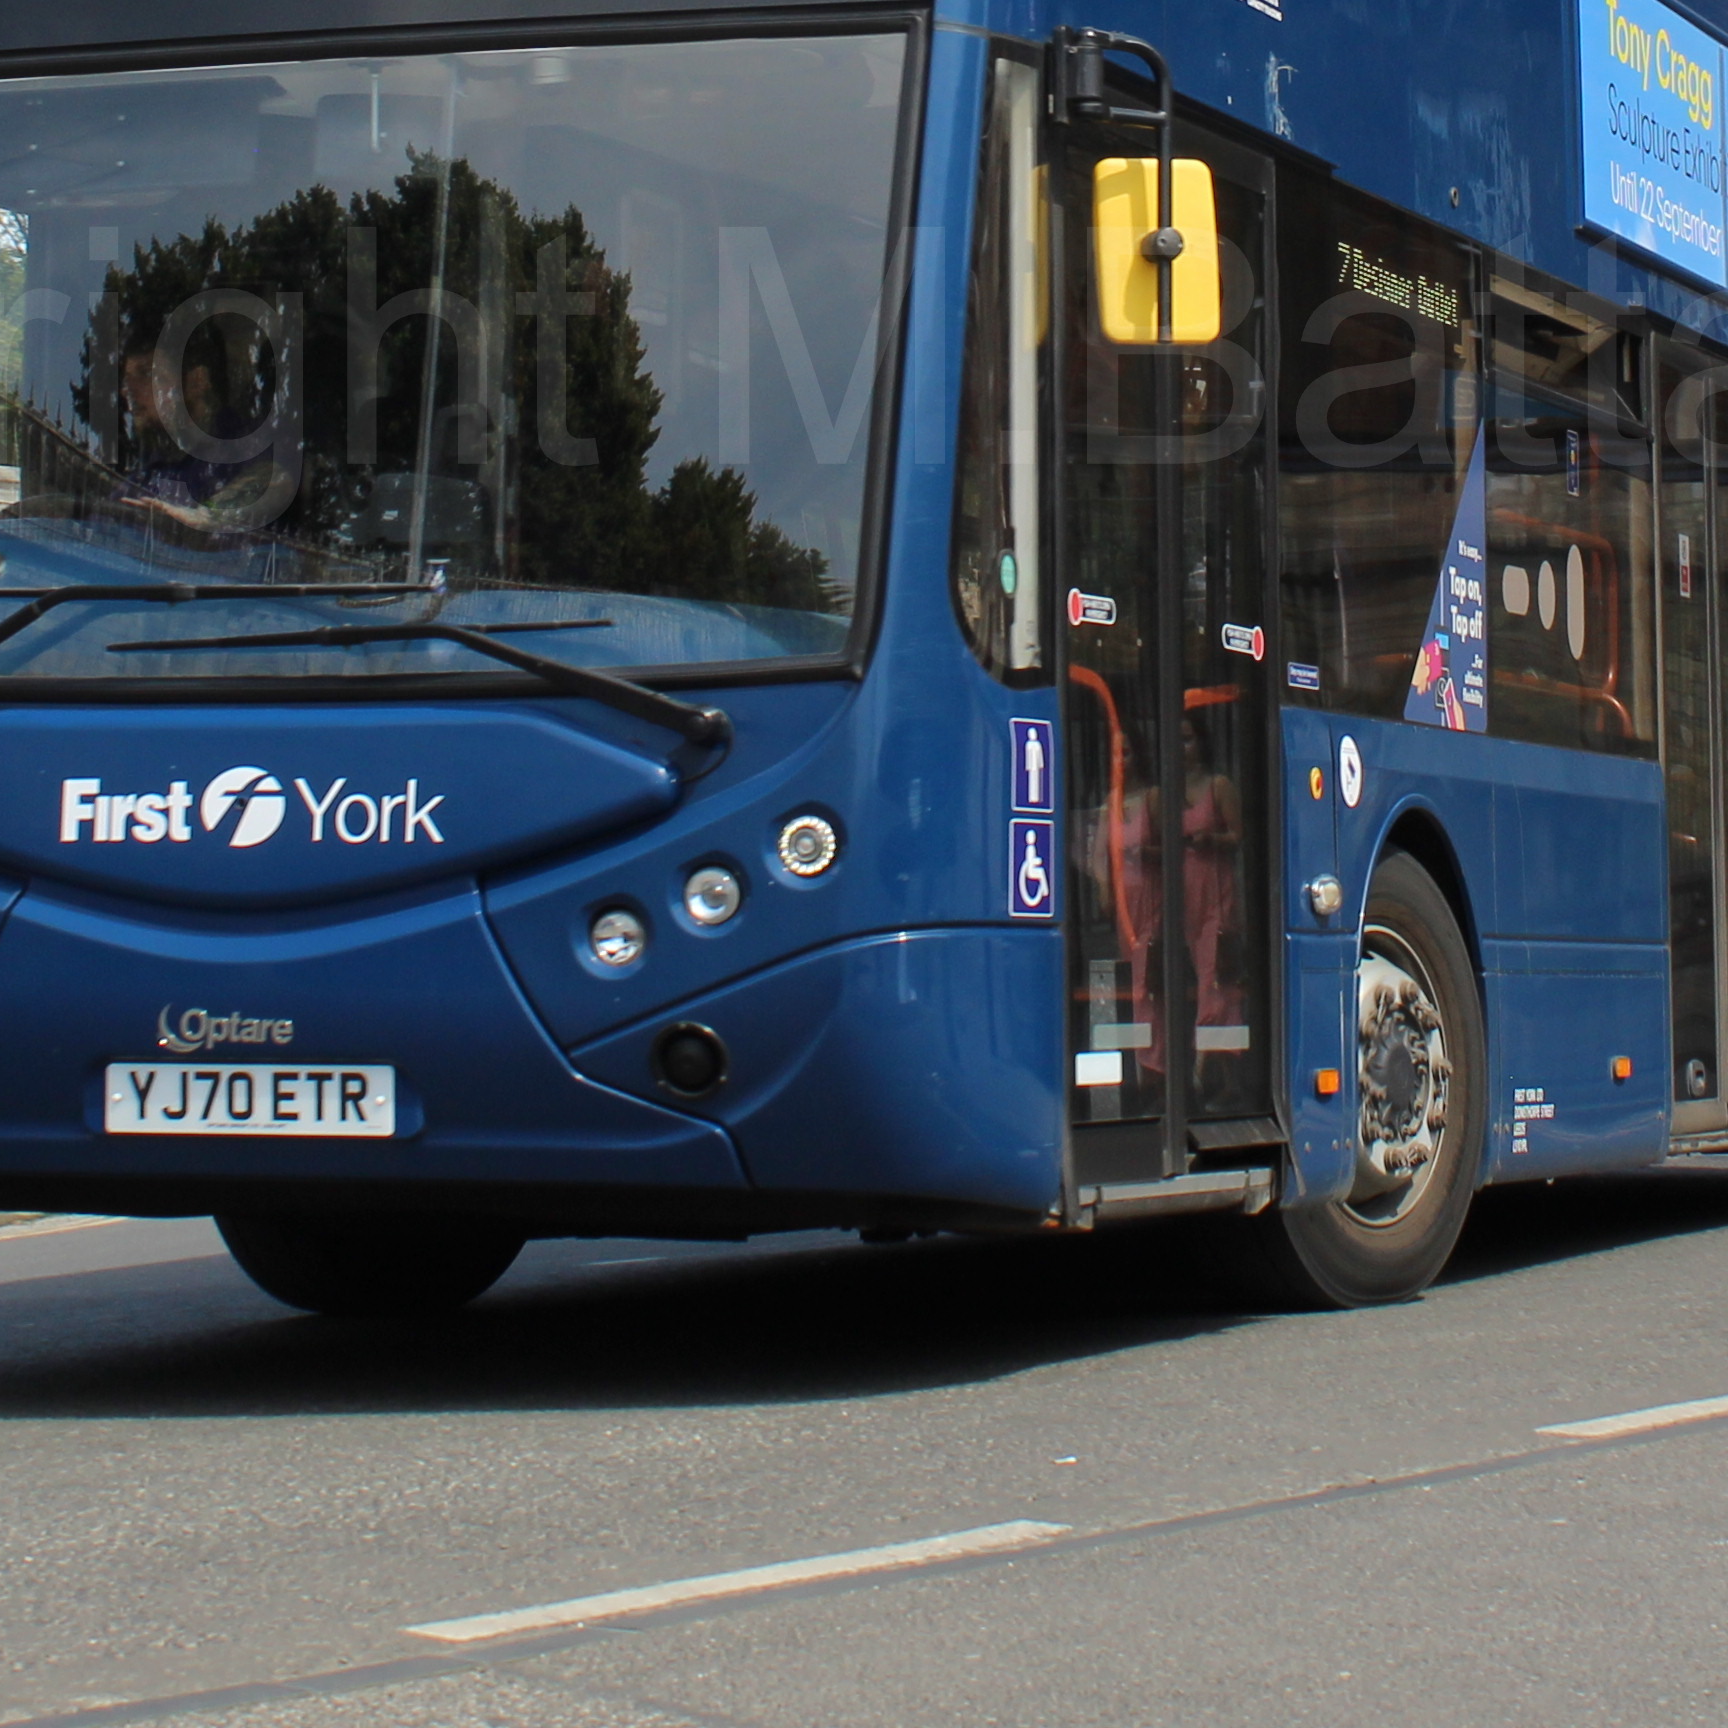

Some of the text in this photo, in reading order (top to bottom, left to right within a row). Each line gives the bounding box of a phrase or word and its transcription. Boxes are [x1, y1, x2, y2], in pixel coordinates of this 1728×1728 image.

[1655, 28, 1714, 131] Cragg
[1607, 82, 1680, 171] Sculpture
[1610, 160, 1722, 258] Until 22 September
[1338, 241, 1458, 328] 7 Designer Outlet
[1448, 566, 1482, 606] Tap on,
[1450, 604, 1483, 643] Tap off
[59, 778, 446, 846] First York
[179, 1007, 294, 1049] Optare
[130, 1071, 368, 1122] YJ70 ETR
